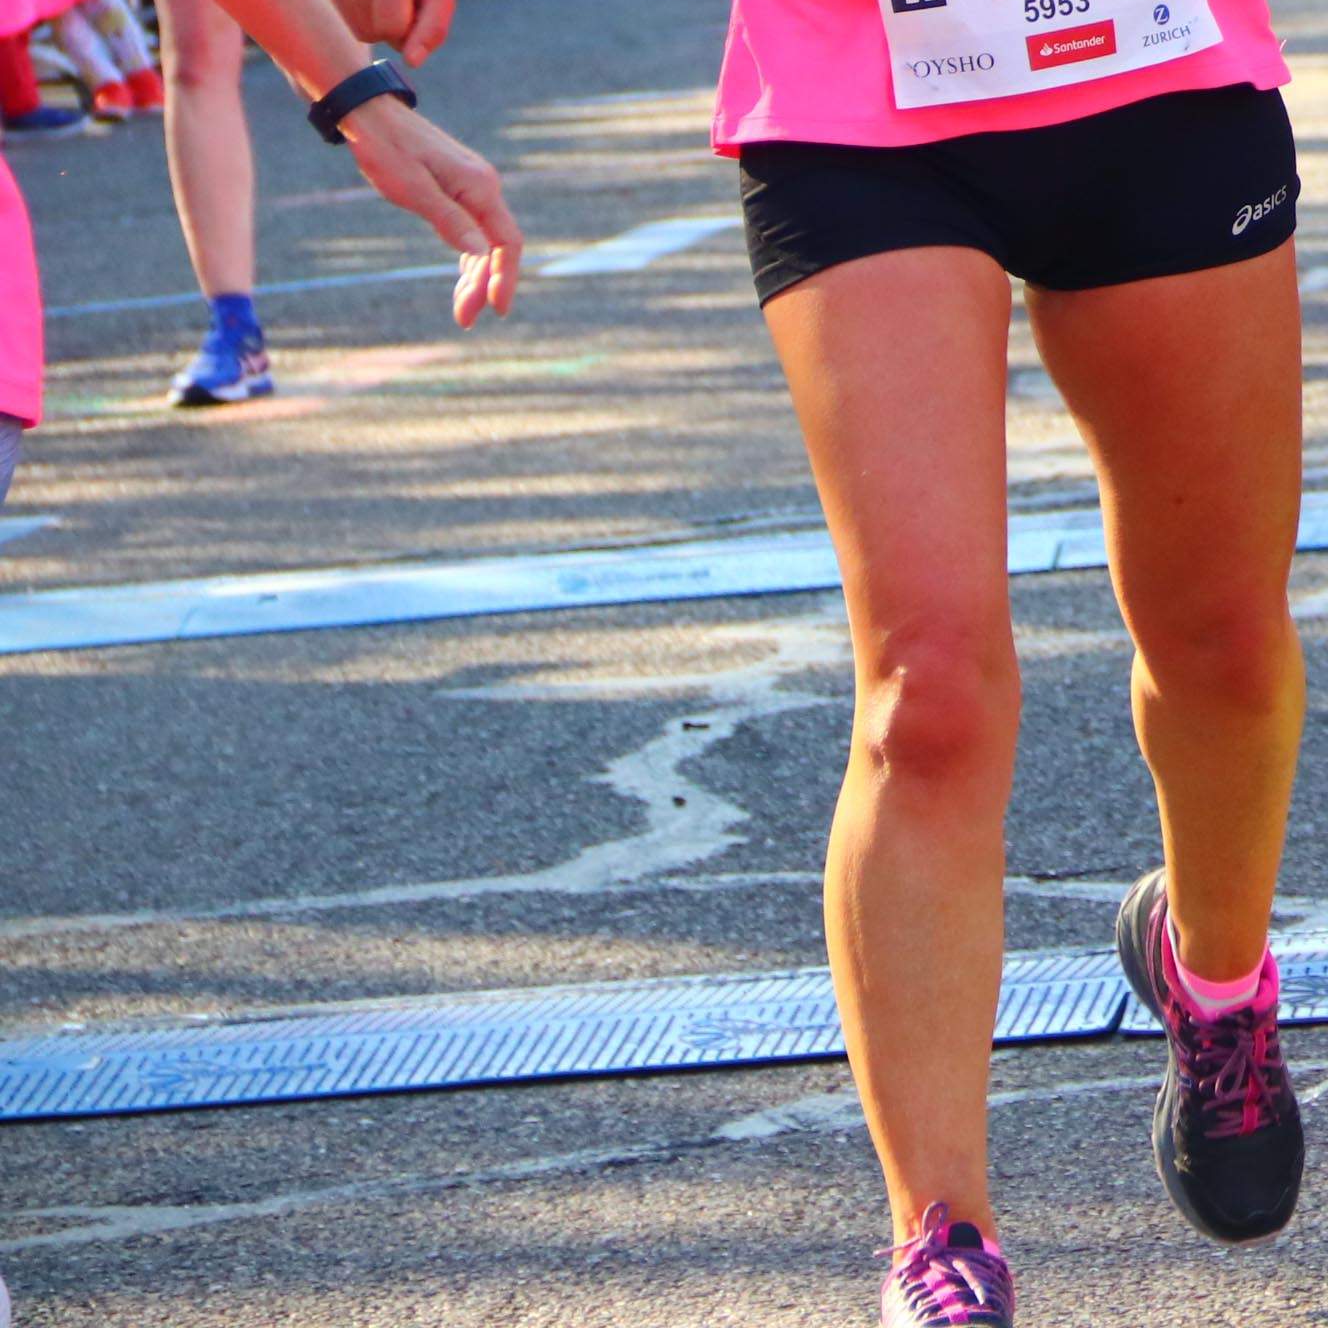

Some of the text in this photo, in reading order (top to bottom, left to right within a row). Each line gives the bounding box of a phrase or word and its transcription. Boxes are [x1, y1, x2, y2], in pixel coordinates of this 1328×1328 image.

[1053, 34, 1105, 55] Santander
[1143, 24, 1192, 48] ZURICH
[912, 53, 994, 78] OYSHO
